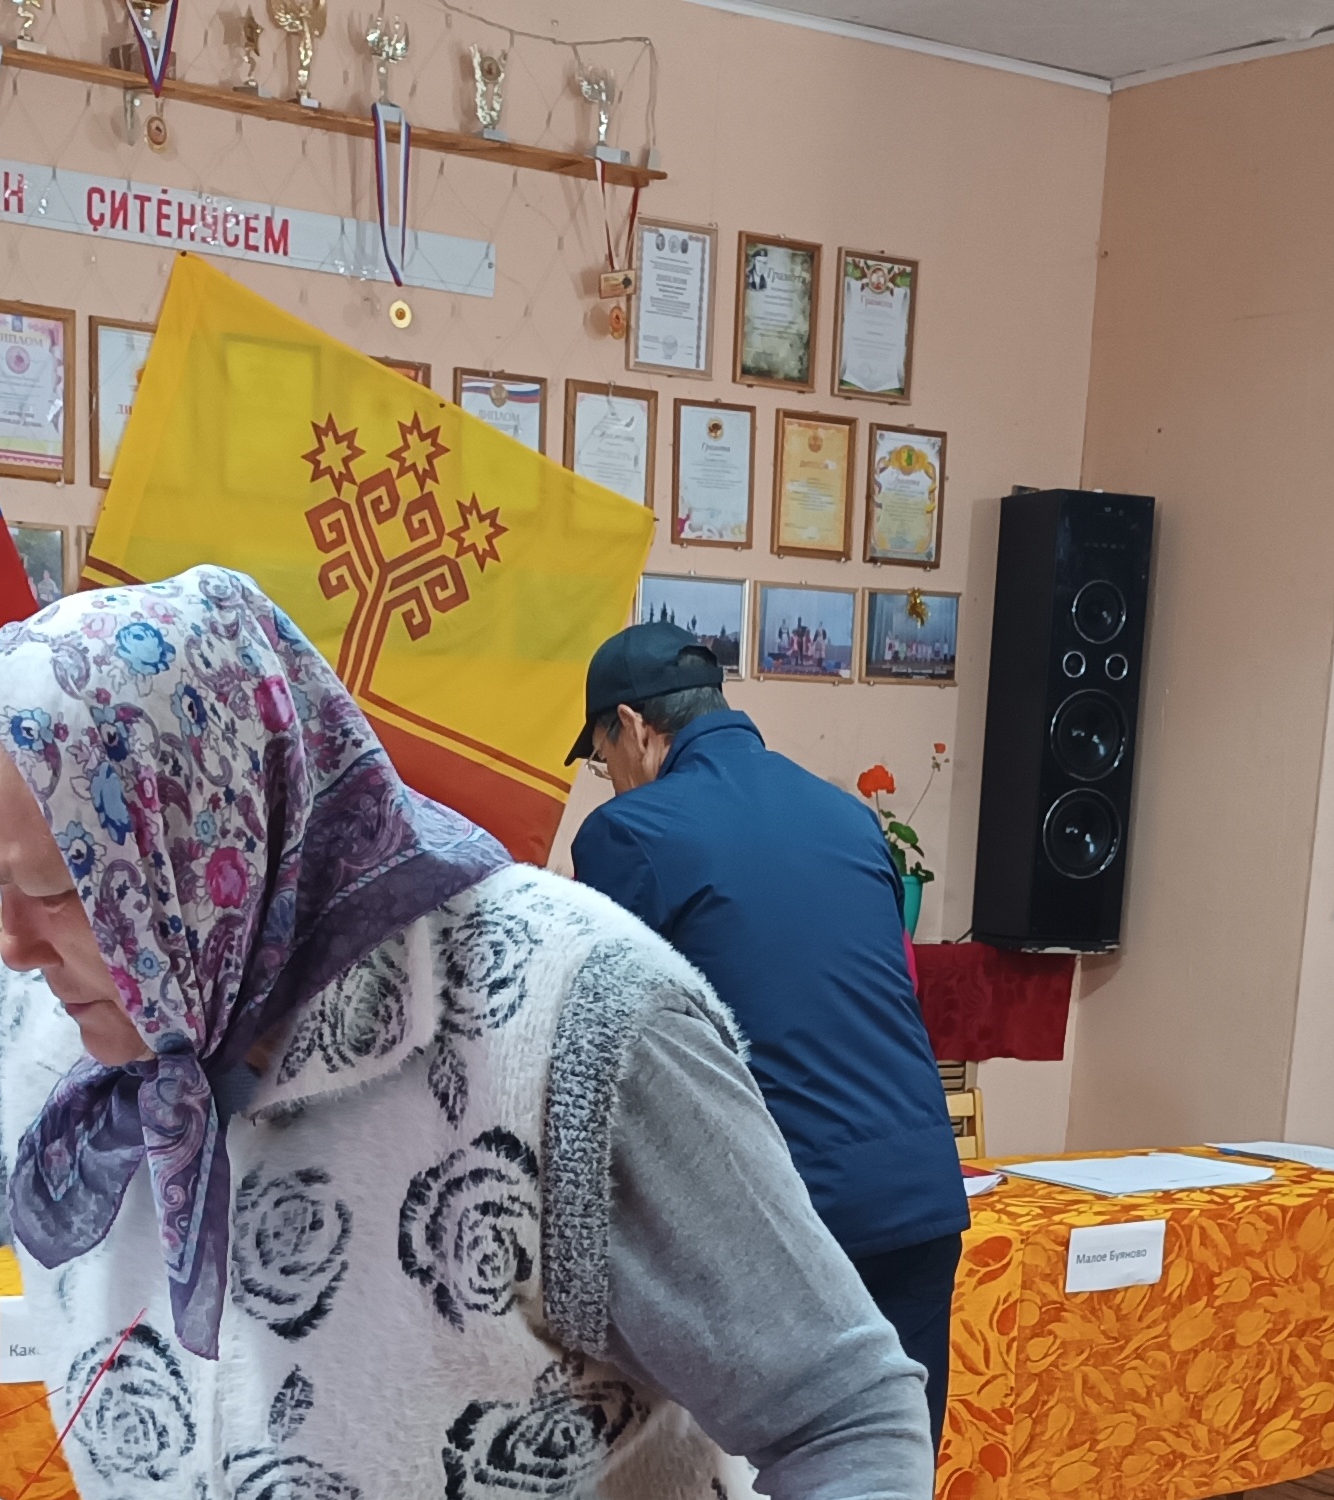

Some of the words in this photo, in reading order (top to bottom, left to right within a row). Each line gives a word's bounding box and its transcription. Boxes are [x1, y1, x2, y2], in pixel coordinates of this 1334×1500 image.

[1076, 1253, 1107, 1264] Малое
[1109, 1248, 1147, 1262] Буяново
[9, 1343, 42, 1357] Как
